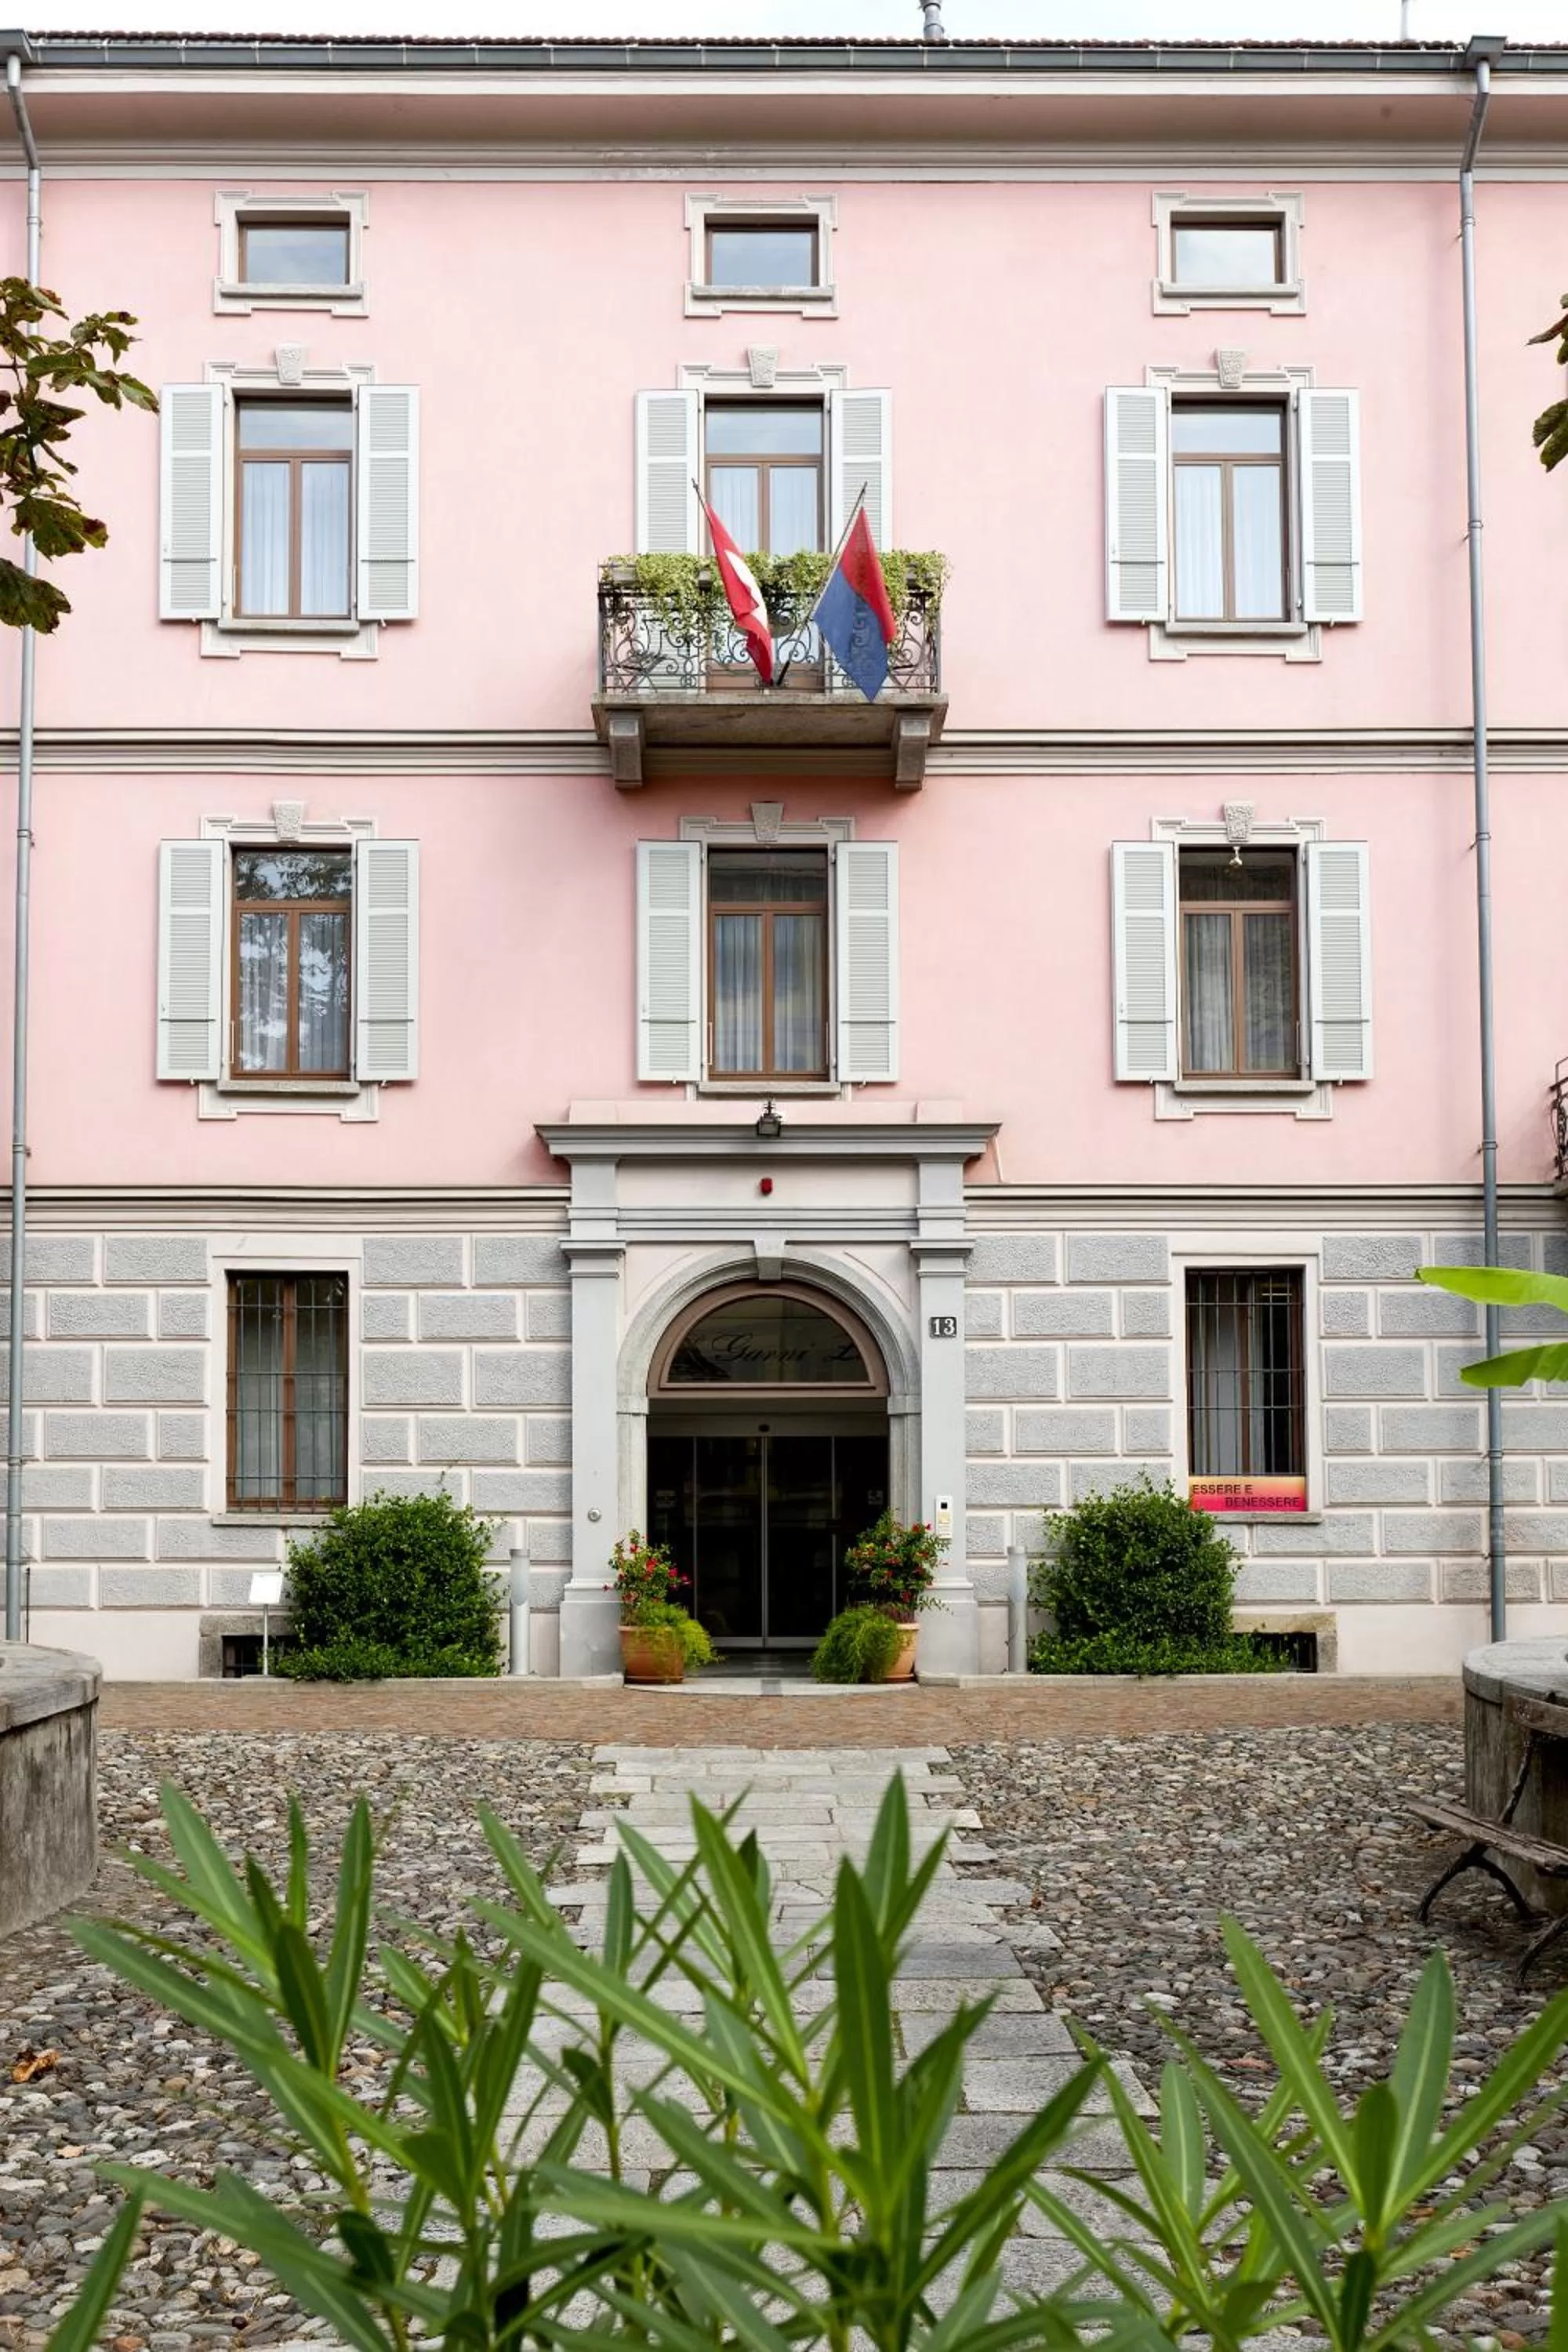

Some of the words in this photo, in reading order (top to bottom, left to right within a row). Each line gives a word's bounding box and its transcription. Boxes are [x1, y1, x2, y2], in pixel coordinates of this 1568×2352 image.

[933, 1318, 956, 1335] 13
[1192, 1484, 1241, 1495] ESSERE
[1245, 1484, 1254, 1494] E
[1225, 1497, 1300, 1508] BENESSERE
